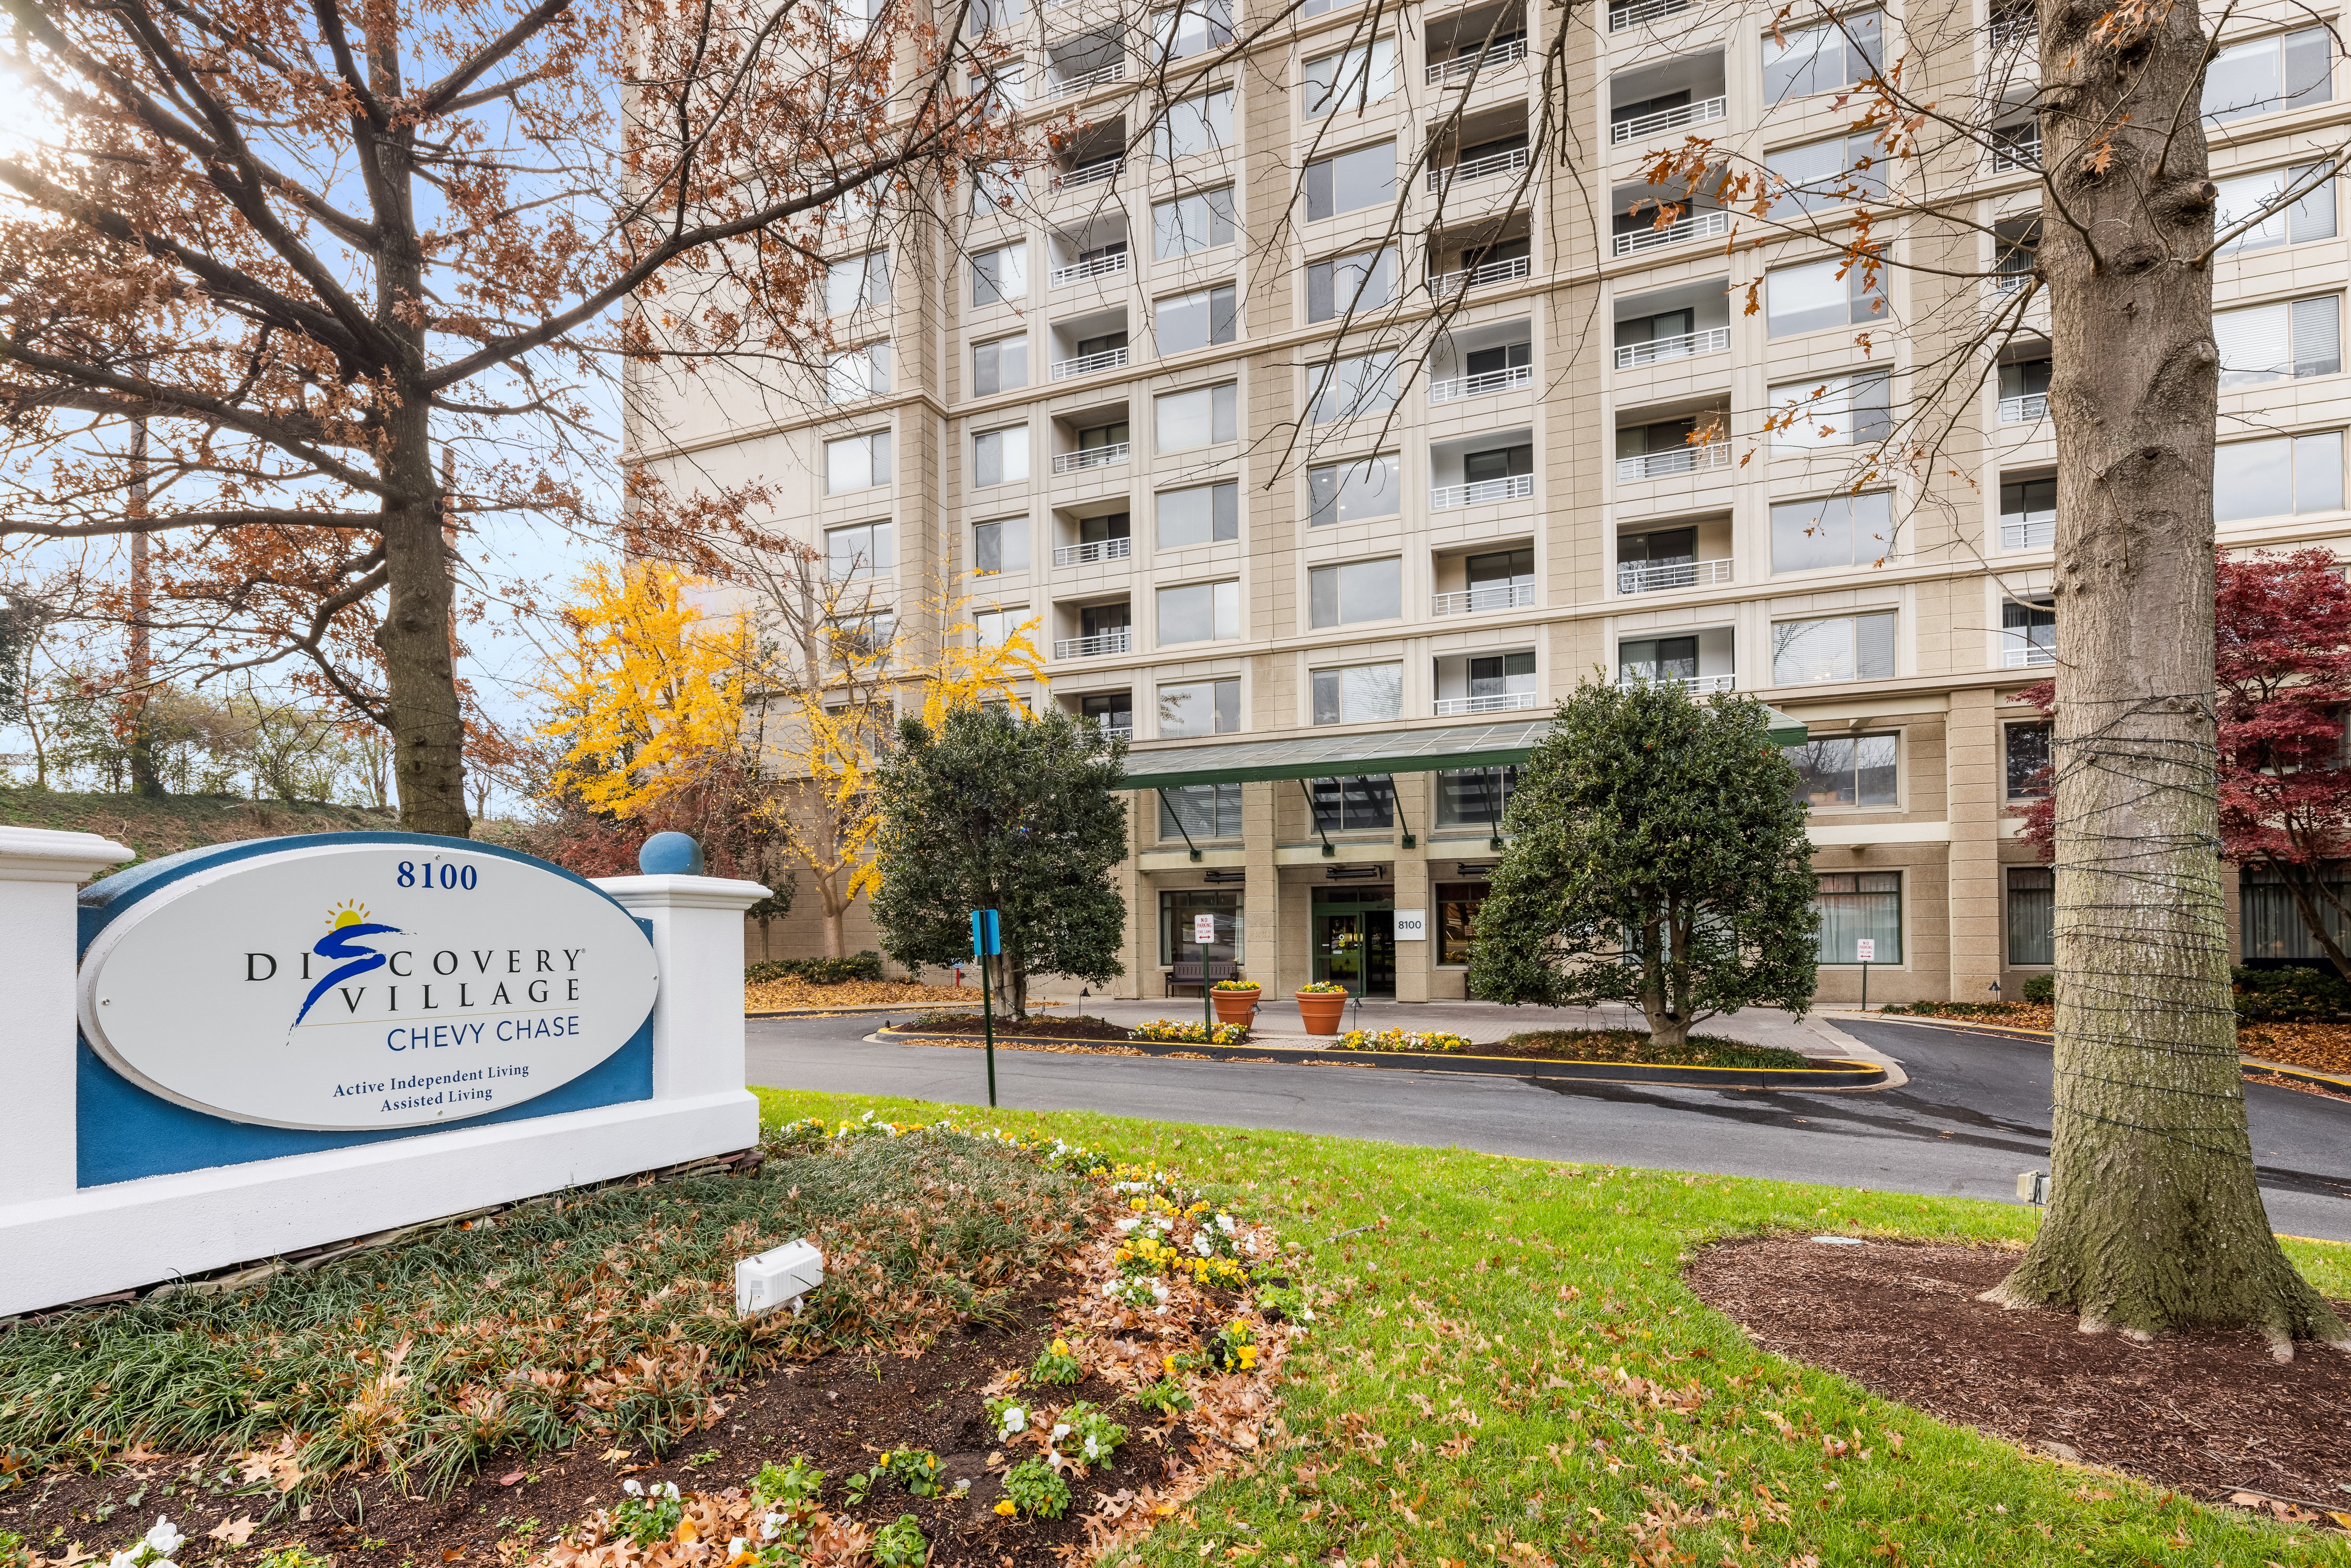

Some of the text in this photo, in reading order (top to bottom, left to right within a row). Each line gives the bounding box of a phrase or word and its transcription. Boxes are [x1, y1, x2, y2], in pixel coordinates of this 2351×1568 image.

[397, 861, 477, 890] 8100
[1398, 921, 1421, 929] 8100
[338, 978, 579, 1014] VILLAGE
[387, 1016, 580, 1051] CHEVY CHASE
[332, 1064, 529, 1097] Active Independent Living
[380, 1087, 493, 1112] Assisted Living
